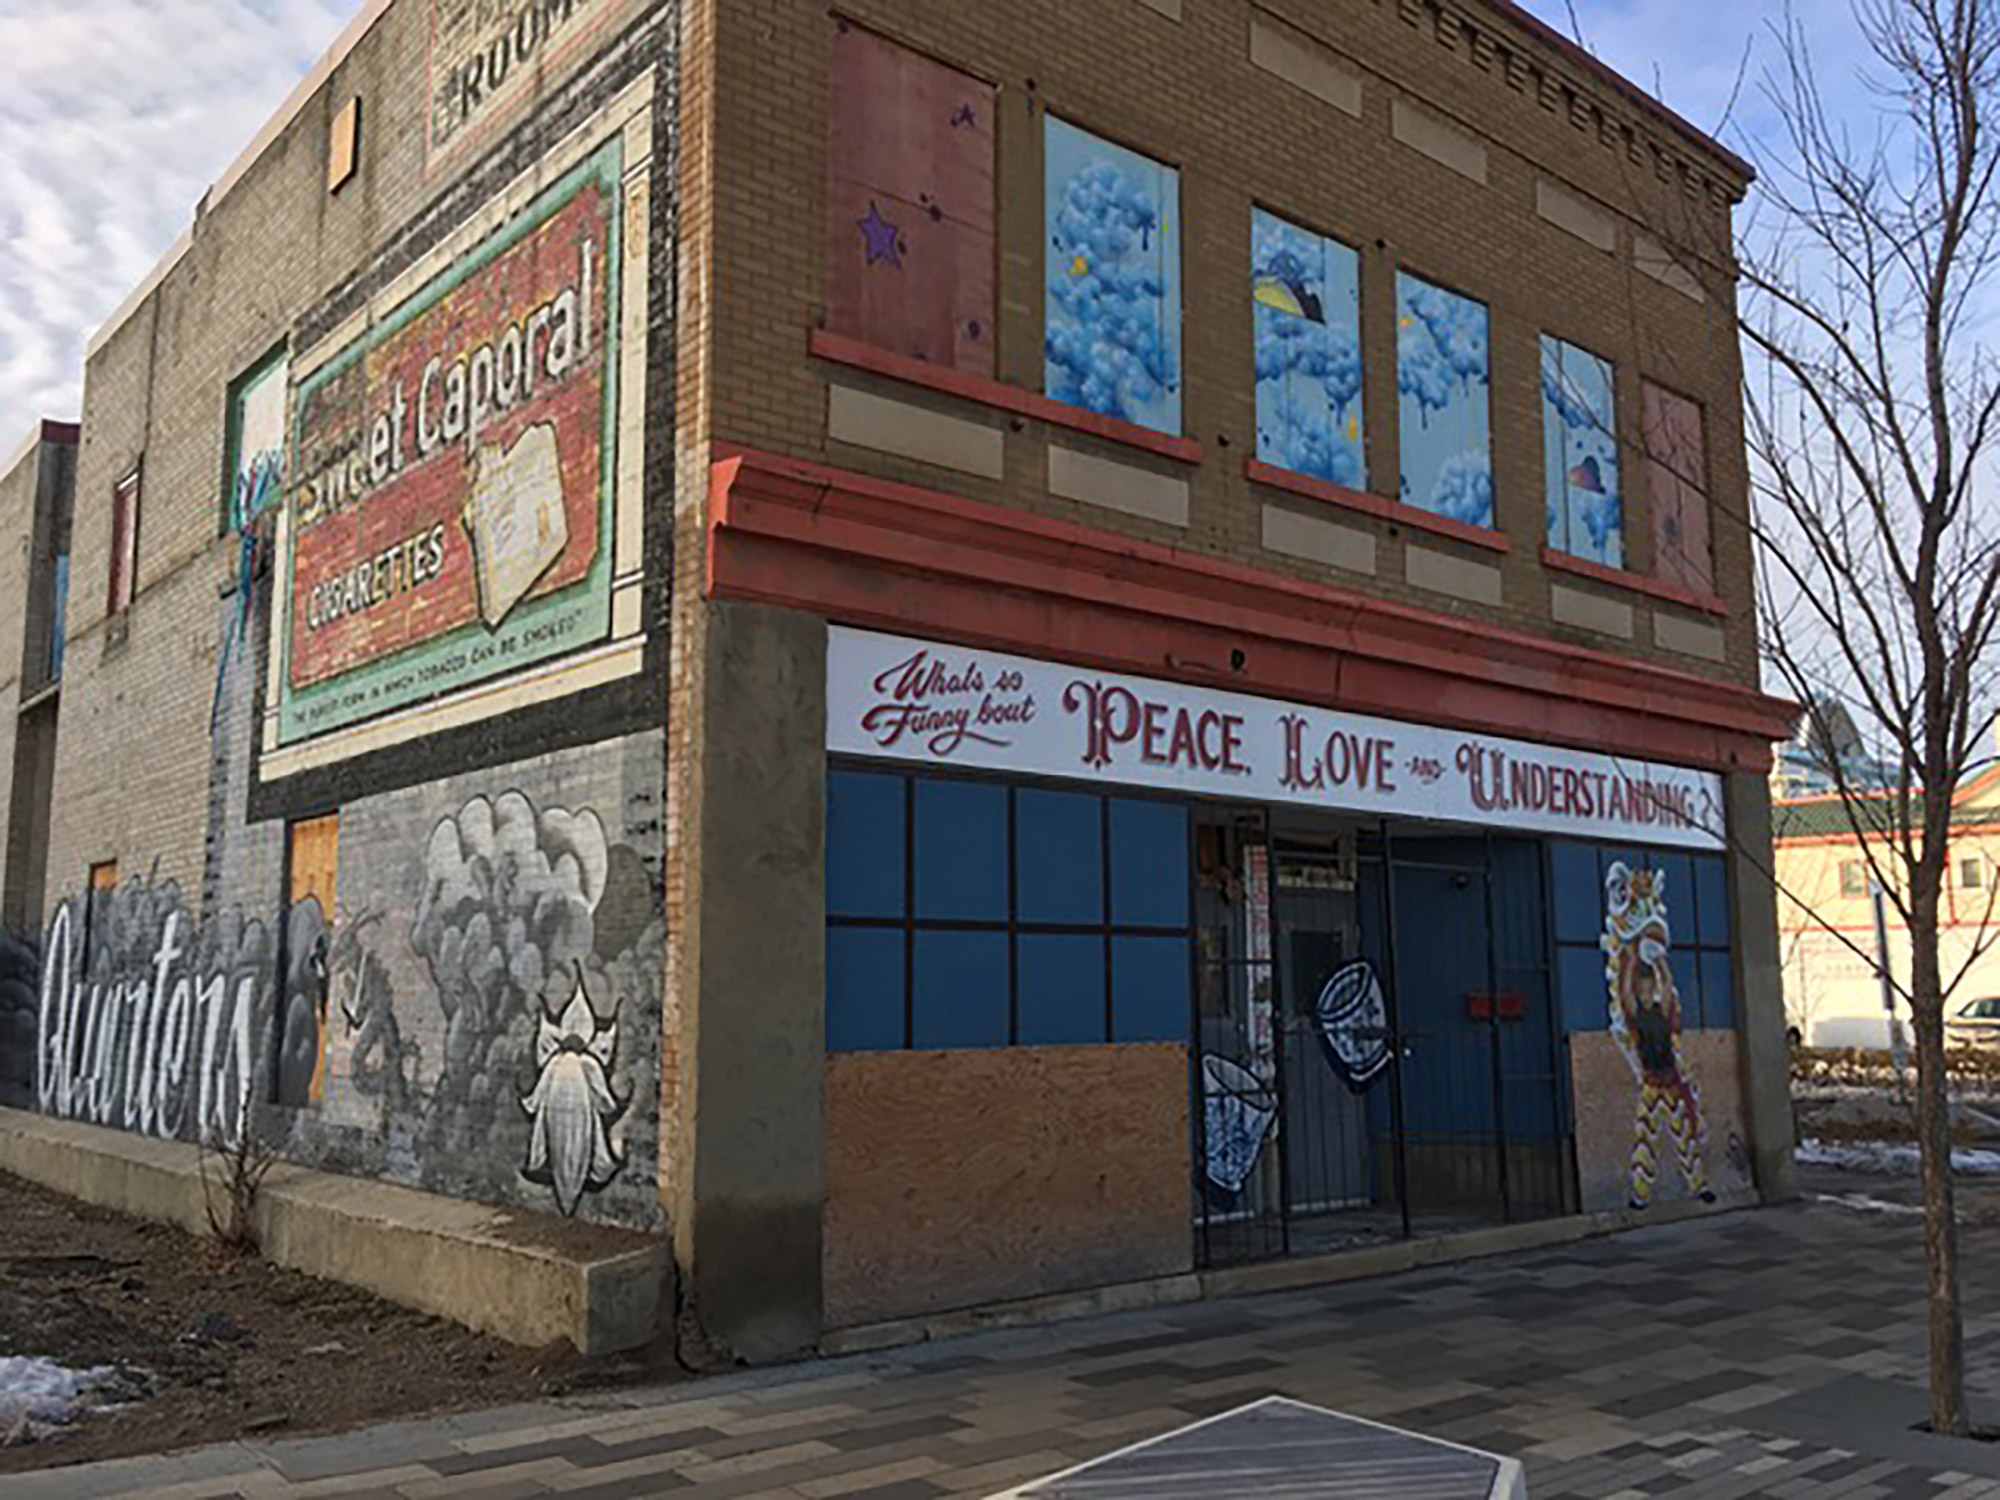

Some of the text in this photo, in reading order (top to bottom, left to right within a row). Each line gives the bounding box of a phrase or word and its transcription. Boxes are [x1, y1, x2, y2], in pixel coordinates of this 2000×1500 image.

[418, 238, 598, 460] Caporal
[992, 671, 1024, 691] so
[861, 695, 1035, 757] Funny bout
[1275, 712, 1397, 793] LOVE
